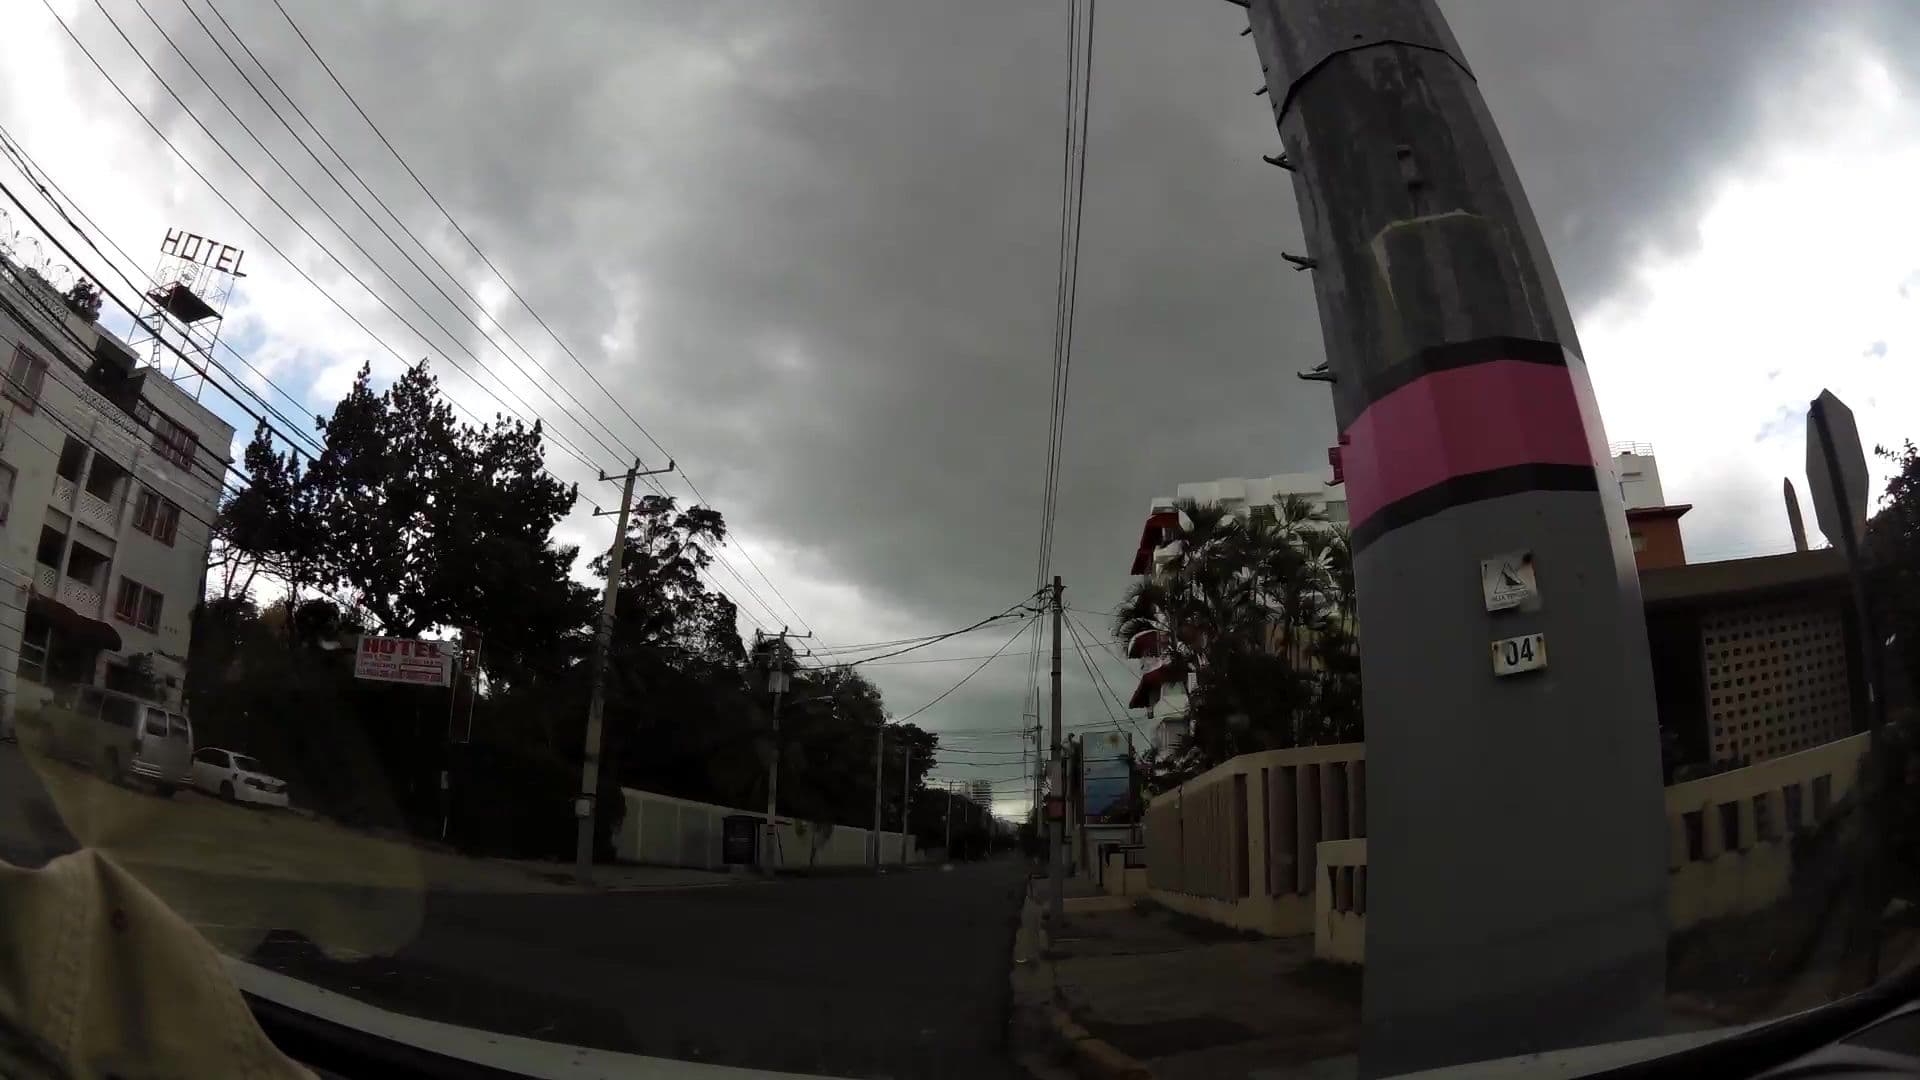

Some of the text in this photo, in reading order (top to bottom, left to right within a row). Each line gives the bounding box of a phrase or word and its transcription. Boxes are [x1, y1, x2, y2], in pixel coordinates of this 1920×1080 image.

[161, 227, 247, 277] HOTEL
[362, 638, 441, 659] HOTEL
[1506, 637, 1534, 666] 04
